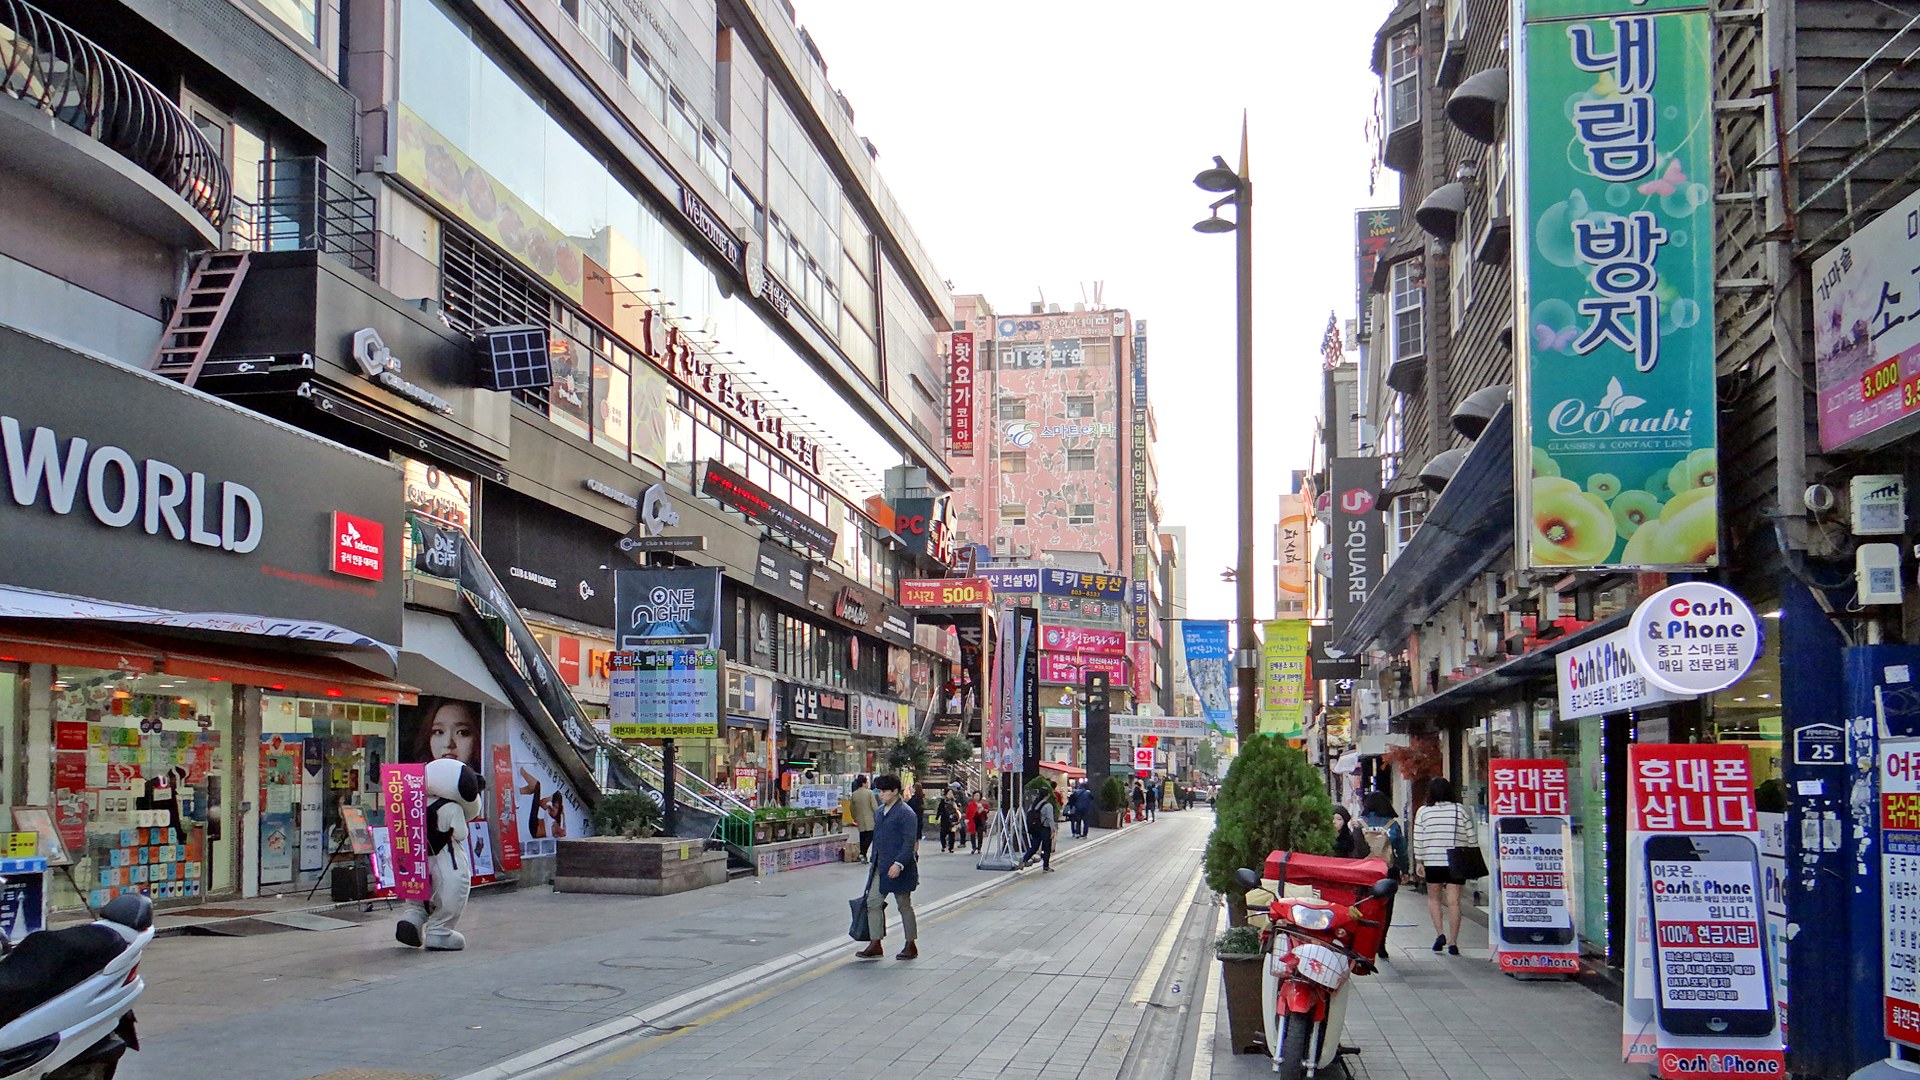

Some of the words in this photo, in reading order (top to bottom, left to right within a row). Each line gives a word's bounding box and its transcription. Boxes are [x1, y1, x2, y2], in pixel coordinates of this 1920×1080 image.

[683, 188, 727, 251] Welcome
[728, 240, 737, 262] to
[1370, 226, 1396, 237] New
[1817, 247, 1854, 301] 가마솥
[1019, 321, 1041, 331] SBS
[1864, 361, 1899, 398] 3,000
[1548, 441, 1596, 450] GLASSES
[1611, 440, 1660, 449] CONTACT
[1664, 439, 1693, 448] LENS
[0, 416, 263, 553] WORLD
[896, 515, 924, 535] PC
[341, 534, 353, 547] SK
[354, 541, 379, 554] telecom
[434, 533, 455, 554] ONE
[341, 552, 352, 563] 공식
[1345, 520, 1367, 603] SQUARE
[1051, 571, 1079, 587] 럭키
[1080, 574, 1122, 592] 부동산
[649, 586, 694, 607] ONE
[907, 590, 935, 602] 1시간
[1136, 582, 1147, 604] 럭키
[1670, 597, 1733, 617] Cash
[631, 605, 694, 629] NIGHT
[1136, 606, 1148, 639] 부동산
[1648, 621, 1663, 639] &
[1667, 621, 1746, 639] Phone
[1657, 644, 1682, 657] 중고
[1687, 643, 1739, 656] 스마트폰
[613, 655, 642, 667] 쥬디스
[646, 654, 675, 667] 패션몰
[679, 653, 714, 666] 지하1층
[1569, 650, 1596, 691] Cash
[1596, 646, 1604, 683] &
[1659, 659, 1683, 673] 매입
[1688, 658, 1739, 672] 전문업체
[795, 687, 818, 720] 삼보
[1571, 693, 1582, 712] 중고
[1583, 688, 1605, 709] 스마트폰
[1606, 685, 1618, 704] 매입
[1620, 677, 1647, 701] 전문업체
[696, 726, 714, 735] 타는곳
[1027, 718, 1033, 726] of
[1137, 750, 1152, 768] 약
[1811, 744, 1834, 759] 25
[1494, 769, 1565, 790] 휴대폰
[1639, 759, 1748, 792] 휴대폰
[800, 790, 826, 798] 에스컬레이터
[1494, 792, 1567, 813] 삽니다
[1642, 795, 1753, 829] 삽니다
[1500, 846, 1525, 855] Cash
[1526, 846, 1532, 855] &
[1533, 846, 1563, 855] Phone
[1654, 864, 1707, 878] 이곳은...
[1504, 875, 1526, 886] 100%
[1654, 880, 1690, 894] Cash
[1692, 880, 1702, 894] &
[1704, 880, 1751, 895] Phone
[1709, 905, 1755, 919] 입니다.
[1661, 926, 1694, 943] 100%
[1697, 925, 1754, 944] 현금지급!
[1693, 952, 1711, 962] 매입
[1666, 964, 1686, 975] 당일
[1706, 965, 1733, 975] 최고가
[1667, 977, 1689, 987] DATA
